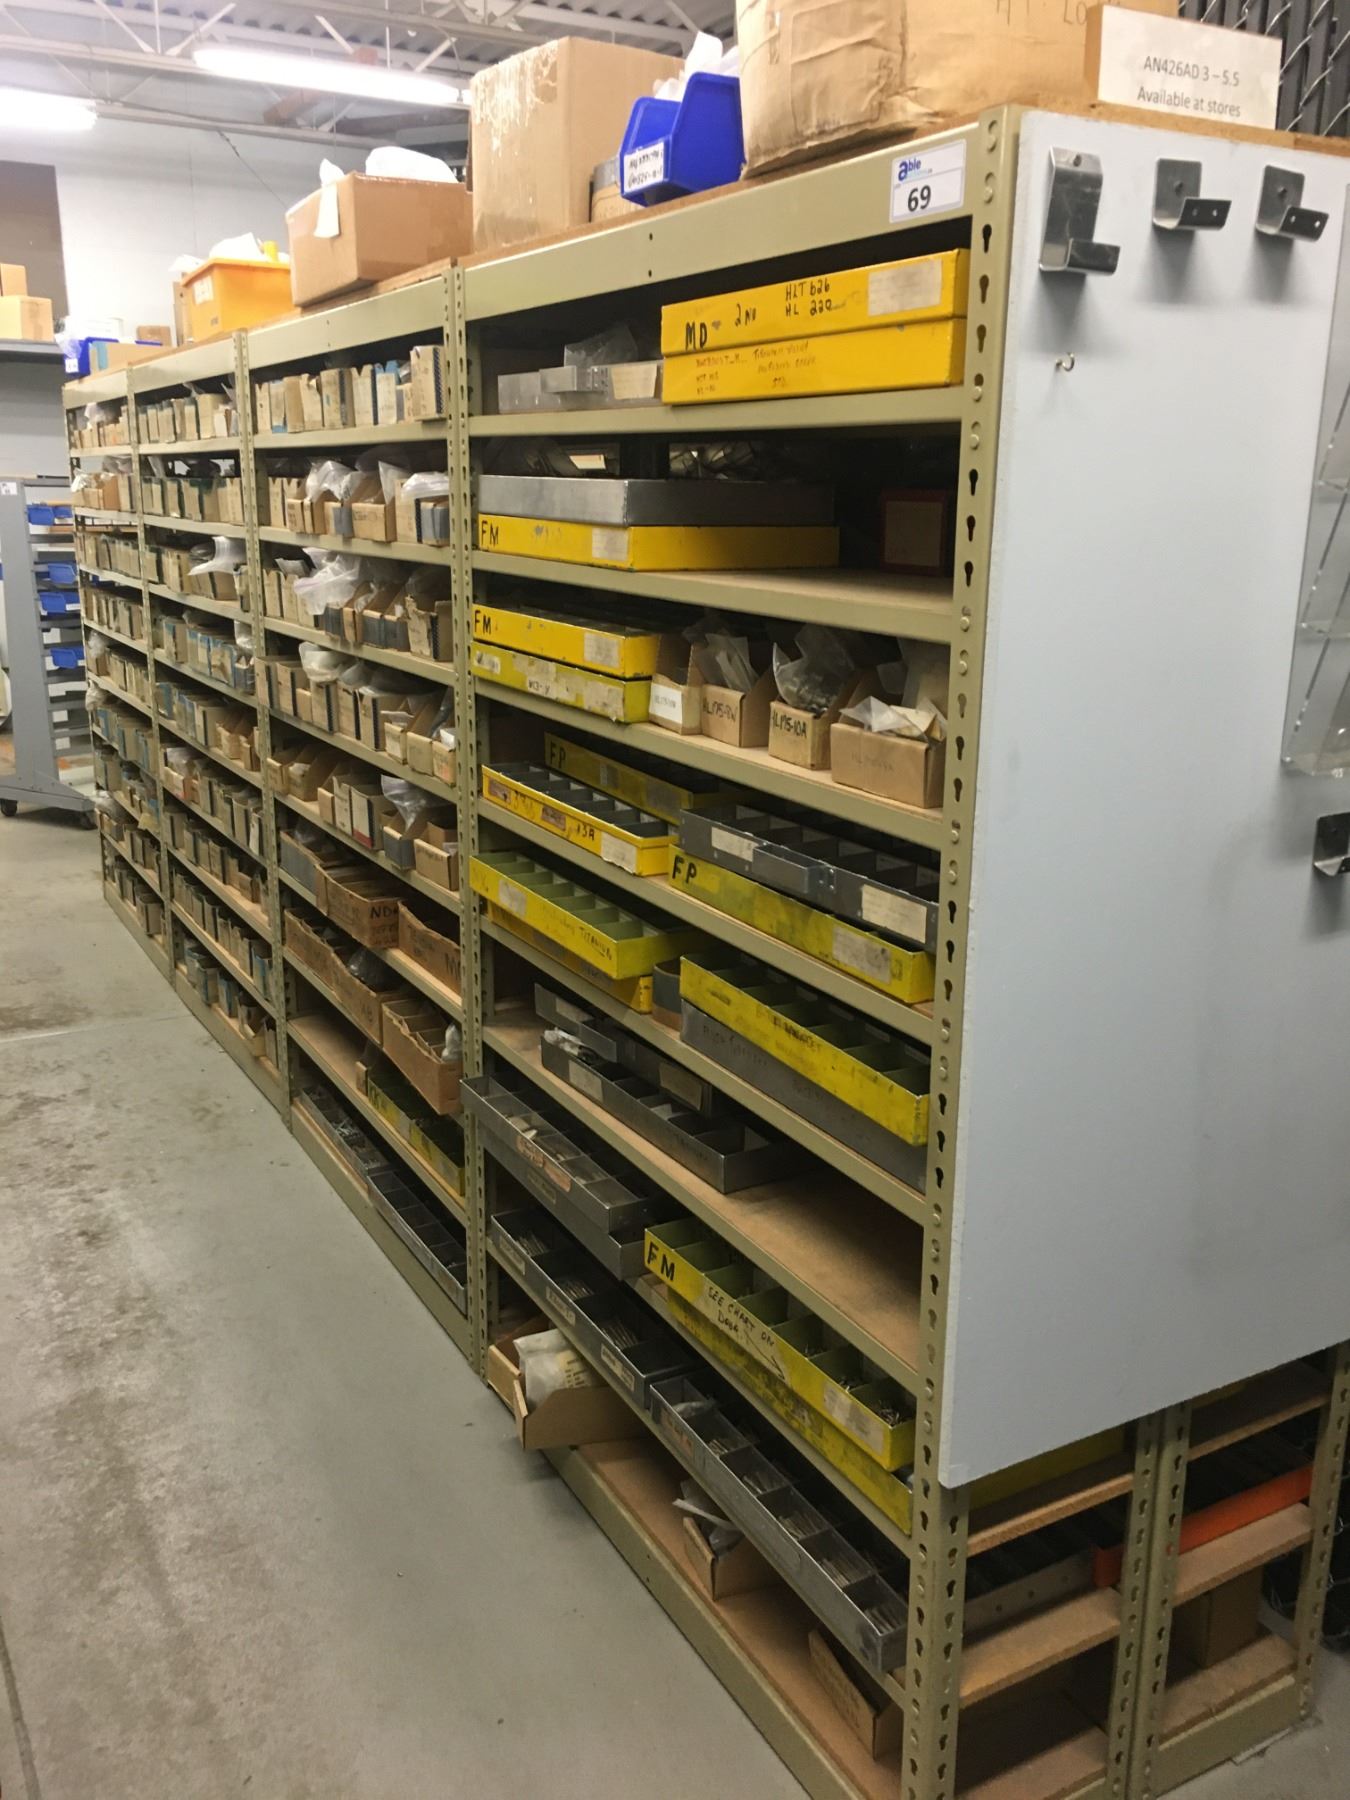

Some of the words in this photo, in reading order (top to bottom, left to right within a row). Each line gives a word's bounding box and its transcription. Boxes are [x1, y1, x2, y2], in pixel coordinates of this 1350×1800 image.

[1144, 55, 1200, 79] AN426AD
[1203, 65, 1210, 82] 3
[1222, 69, 1241, 87] 5.5
[1137, 86, 1191, 110] Available
[1194, 97, 1205, 111] at
[1207, 98, 1241, 118] stores
[907, 185, 931, 212] 69
[685, 321, 708, 350] MD
[481, 520, 499, 545] FM
[474, 610, 492, 635] FM
[671, 854, 698, 884] FP
[648, 1242, 675, 1281] FM
